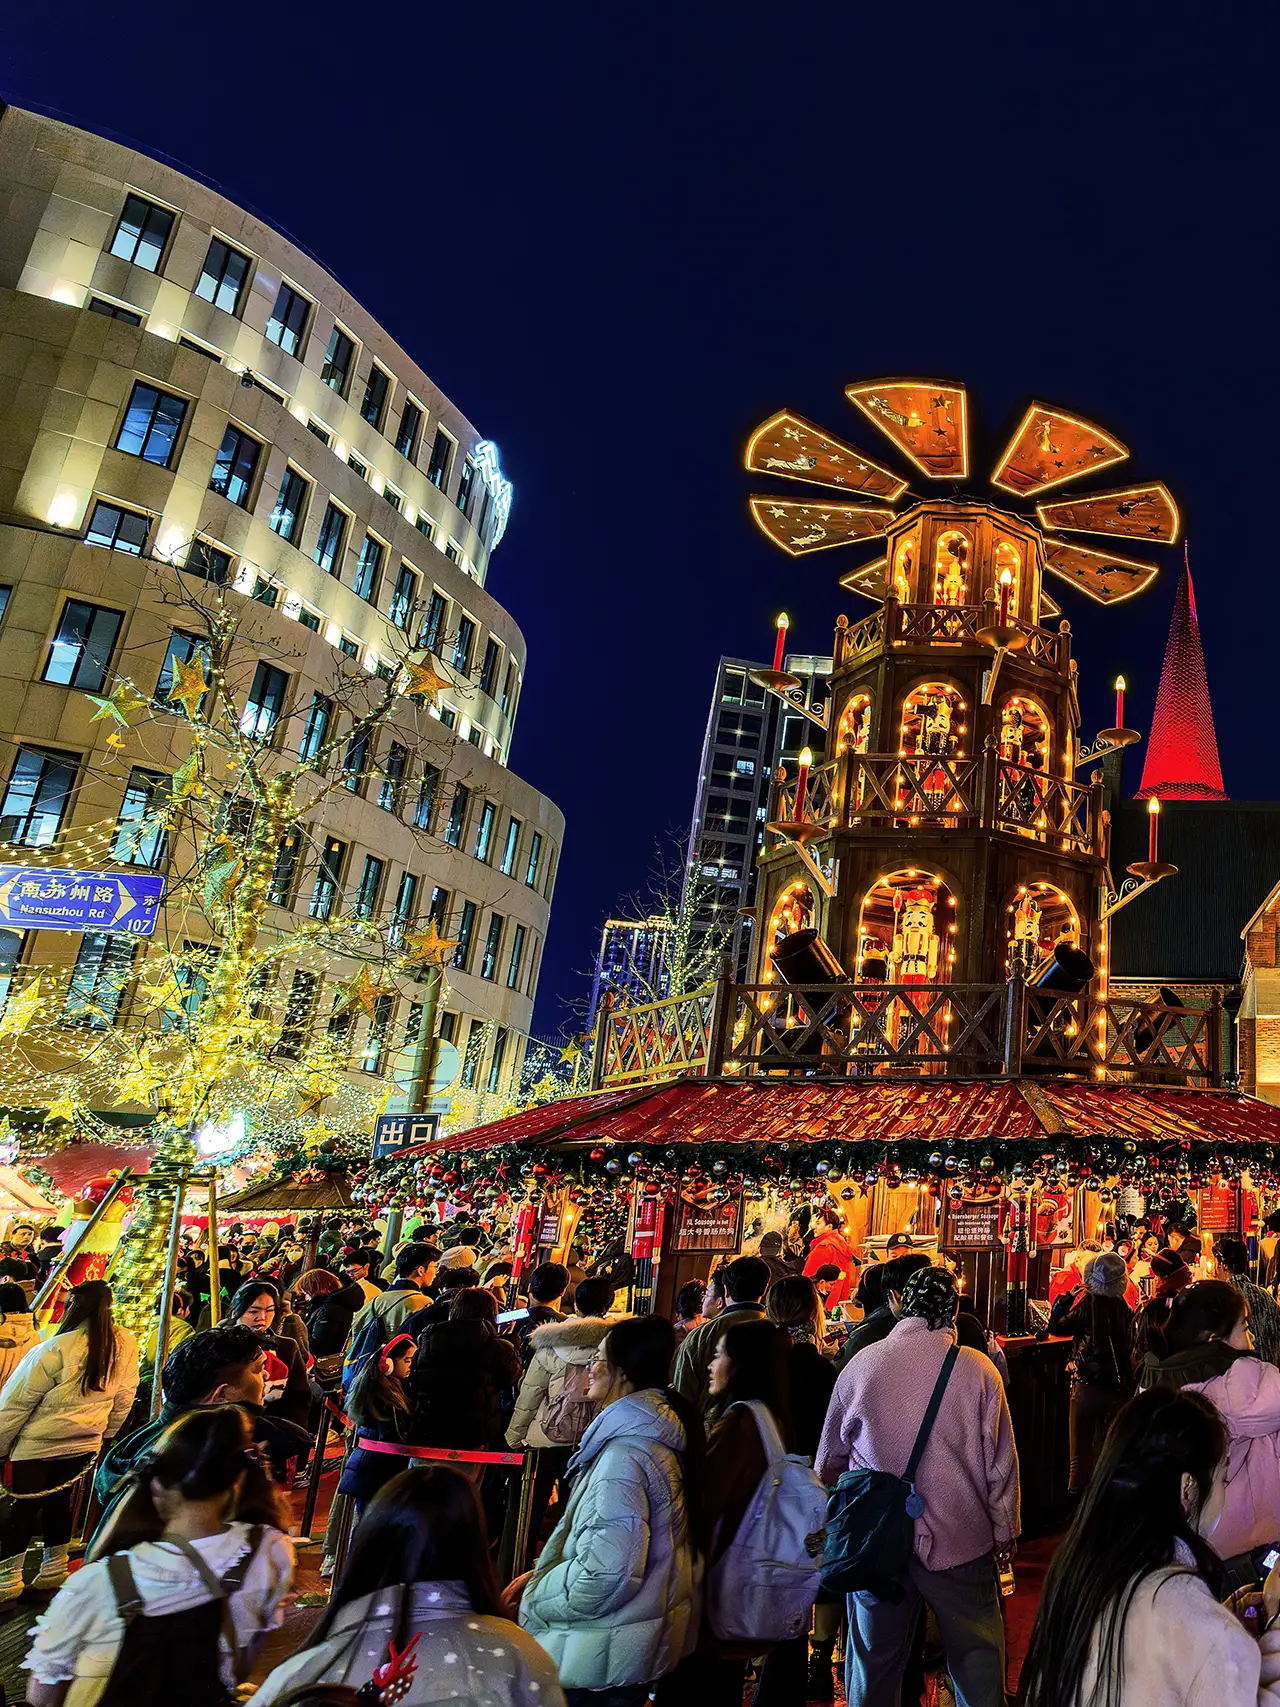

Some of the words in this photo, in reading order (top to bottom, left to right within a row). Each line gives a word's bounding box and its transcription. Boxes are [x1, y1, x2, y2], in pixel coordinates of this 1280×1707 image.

[20, 881, 114, 904] 南苏州路
[20, 904, 83, 917] Nansuzhou
[88, 908, 105, 918] Rd
[127, 919, 151, 933] 107
[380, 1122, 433, 1146] 出口
